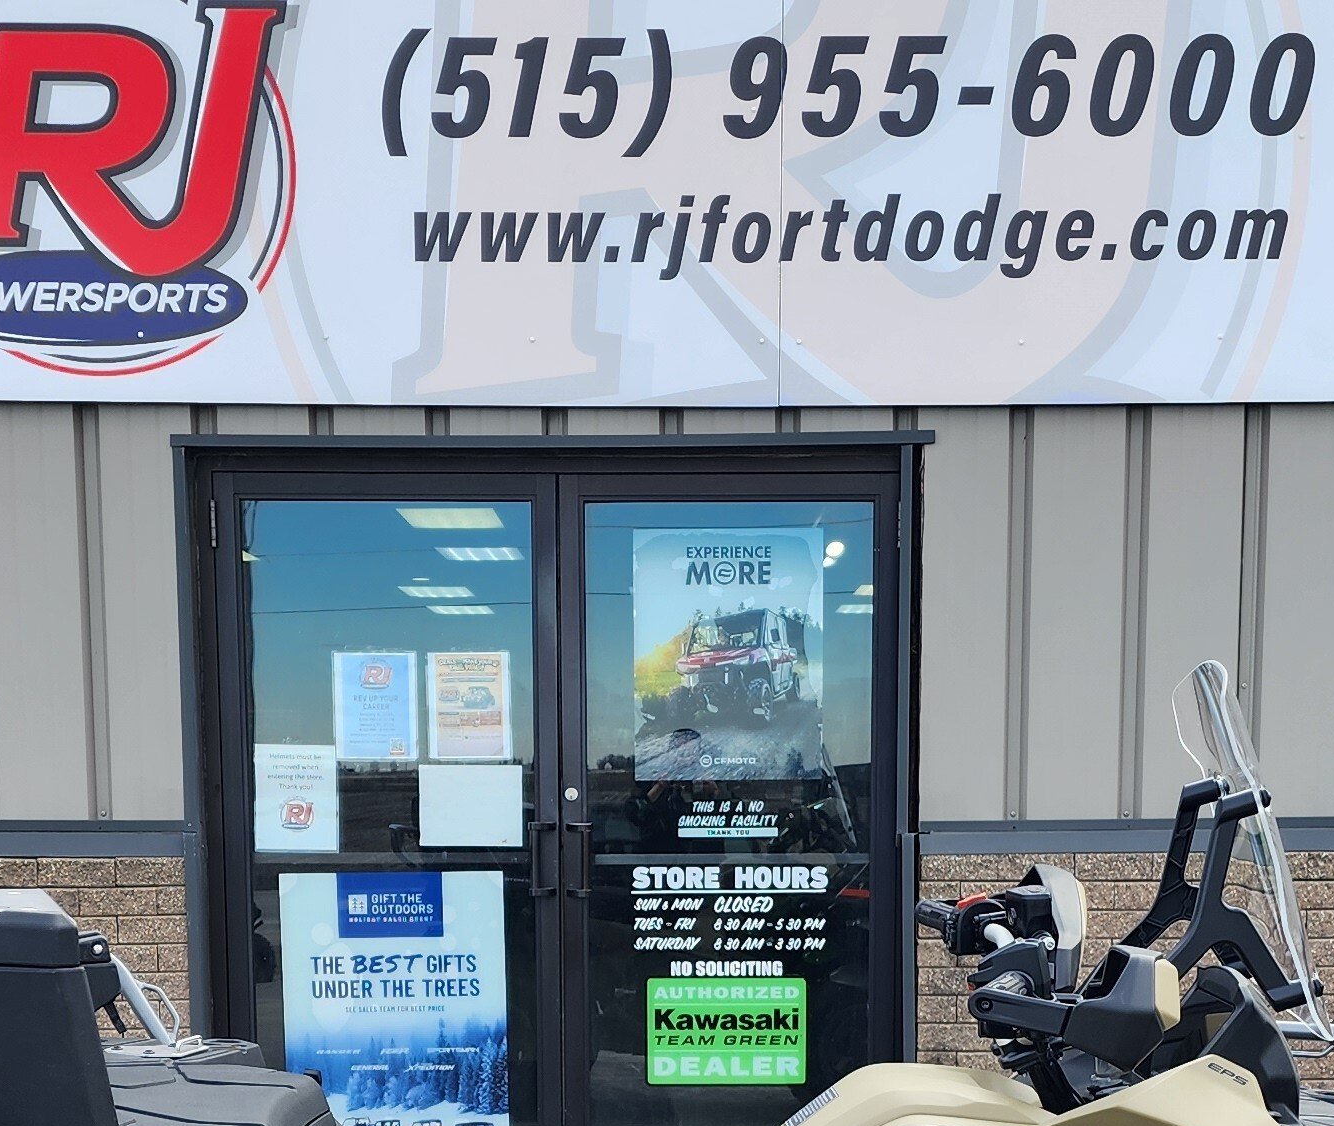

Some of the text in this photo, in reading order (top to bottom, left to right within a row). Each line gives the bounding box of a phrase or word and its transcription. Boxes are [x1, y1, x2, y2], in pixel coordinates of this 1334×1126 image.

[381, 28, 1316, 157] (515) 955-6000
[413, 193, 1289, 281] www.rjfortdodge.com
[686, 545, 772, 559] EXPERIENCE
[685, 560, 772, 586] MORE
[713, 757, 756, 765] CFMOTO
[692, 800, 765, 813] THIS IS A NO
[677, 814, 779, 827] SMOKING FACILITY
[632, 866, 829, 889] STORE HOURS
[371, 893, 422, 904] GIFT THE
[633, 897, 663, 912] SUN
[671, 897, 704, 912] MON
[713, 896, 774, 914] CLOSED
[371, 903, 434, 915] OUTDOORS
[633, 917, 663, 931] TUES
[673, 917, 697, 931] FRI
[741, 918, 765, 931] AM
[803, 918, 826, 931] PM
[633, 937, 701, 950] SATURDAY
[741, 937, 765, 950] AM
[803, 937, 826, 950] PM
[310, 953, 477, 975] THE BEST GIFTS
[670, 960, 783, 977] NO SOLICITING
[311, 978, 480, 999] UNDER THE TREES
[654, 986, 800, 999] AUTHORIZED
[654, 1008, 799, 1031] Kawasaki
[655, 1035, 799, 1046] TEAM GREEN
[653, 1056, 800, 1077] DEALER
[1207, 1062, 1249, 1086] EPS
